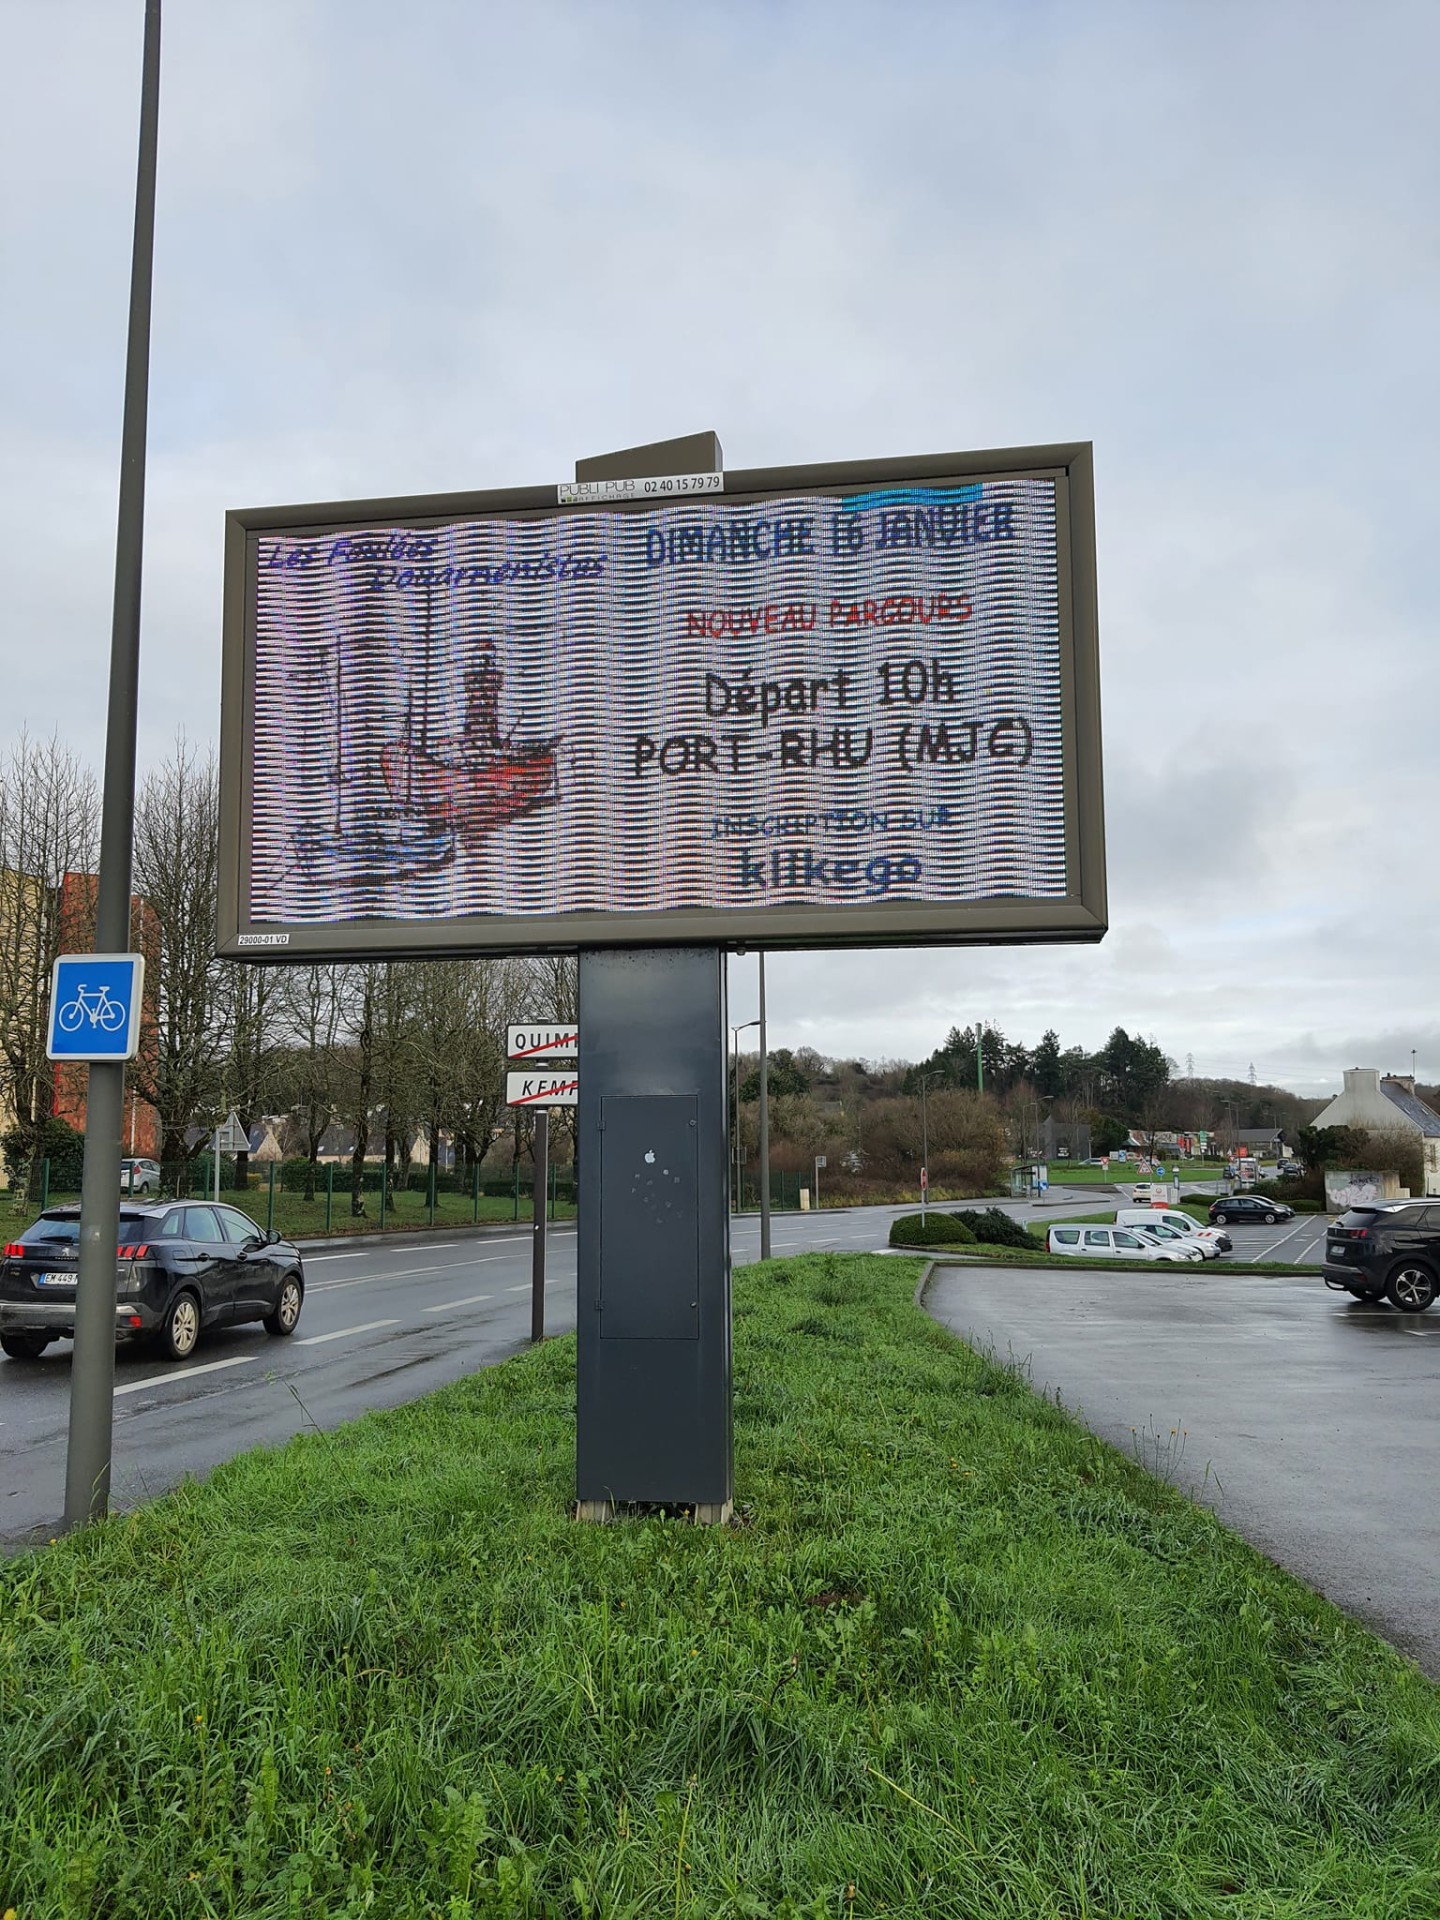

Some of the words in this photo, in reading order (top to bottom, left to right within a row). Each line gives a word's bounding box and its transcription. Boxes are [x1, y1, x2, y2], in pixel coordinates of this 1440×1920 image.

[560, 483, 599, 496] PUBLI
[605, 480, 635, 493] PUB
[644, 481, 657, 493] 02
[660, 480, 673, 491] 40
[677, 479, 688, 490] 15
[691, 478, 704, 489] 79
[707, 476, 720, 488] 79
[646, 517, 815, 566] DIMANCHE
[877, 503, 1014, 549] JANVIER
[687, 601, 816, 638] NOUVEAU
[829, 594, 973, 626] PARCOURS
[705, 667, 850, 728] Départ
[878, 658, 955, 705] 10h
[633, 727, 873, 780] PORT-RHU
[713, 813, 888, 838] INSCRIPTION
[240, 935, 273, 944] 29000-01
[276, 935, 287, 944] VD
